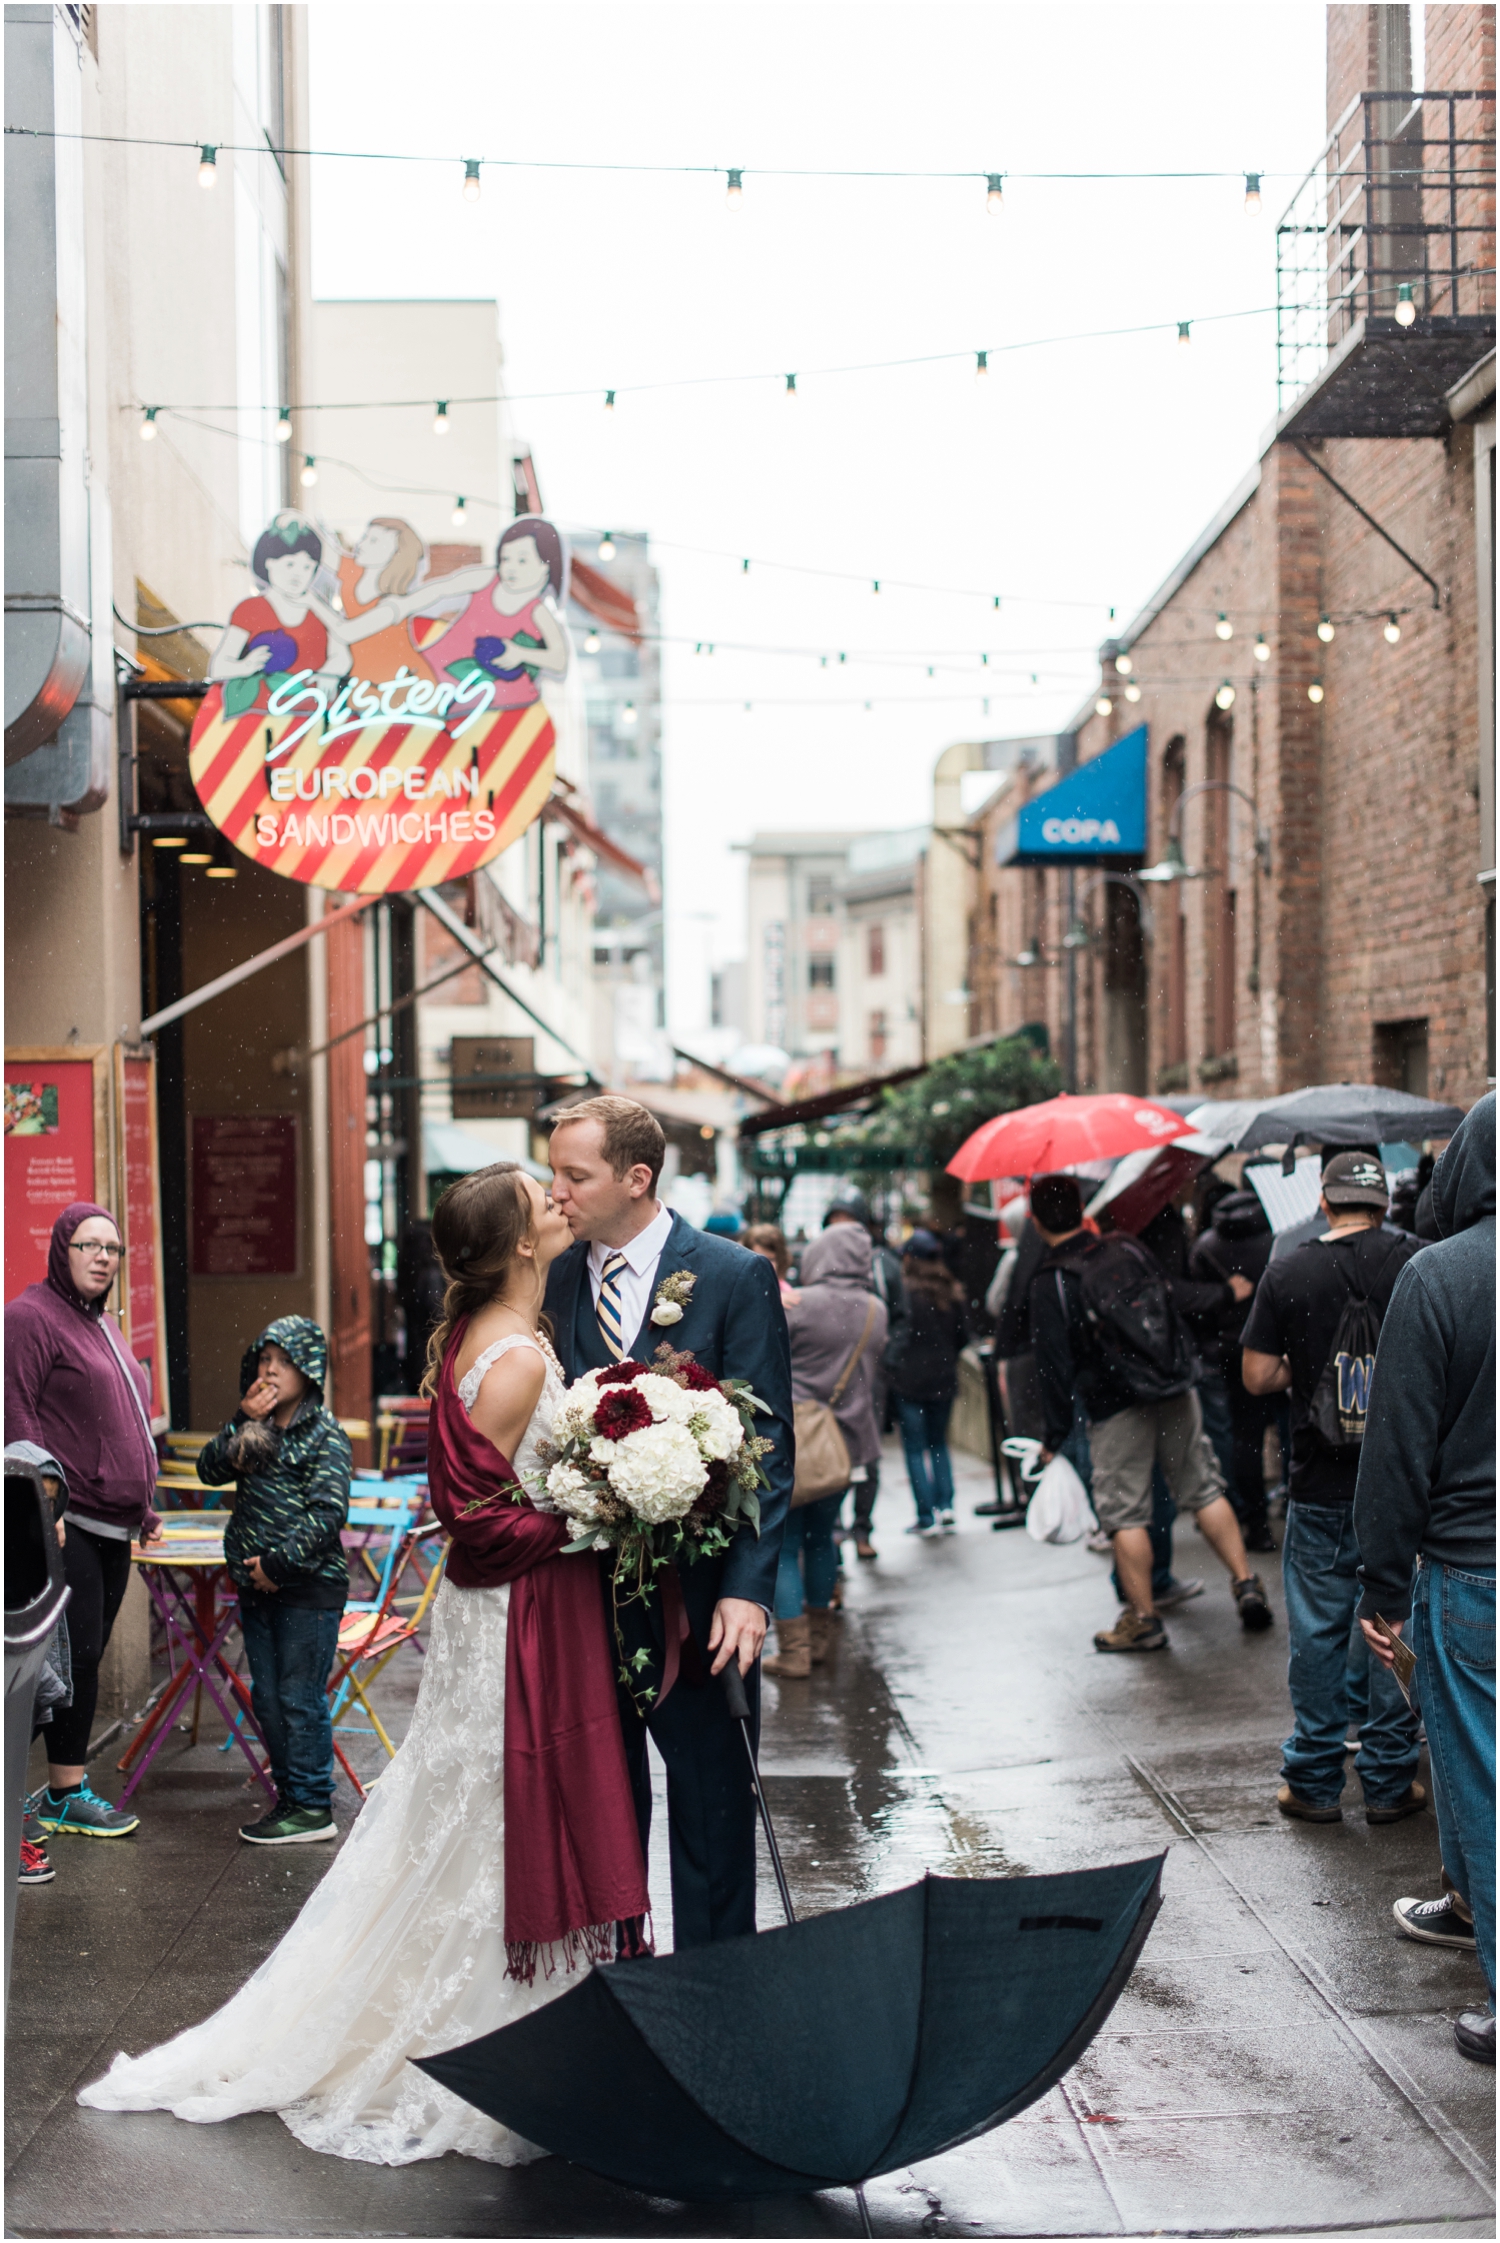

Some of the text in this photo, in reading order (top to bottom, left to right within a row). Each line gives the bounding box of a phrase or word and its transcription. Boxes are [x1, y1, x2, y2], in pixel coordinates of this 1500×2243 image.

[266, 666, 496, 761] Sisters
[271, 767, 479, 801] EUROPEAN
[257, 811, 496, 847] SANDWICHES
[1043, 818, 1120, 843] COPA
